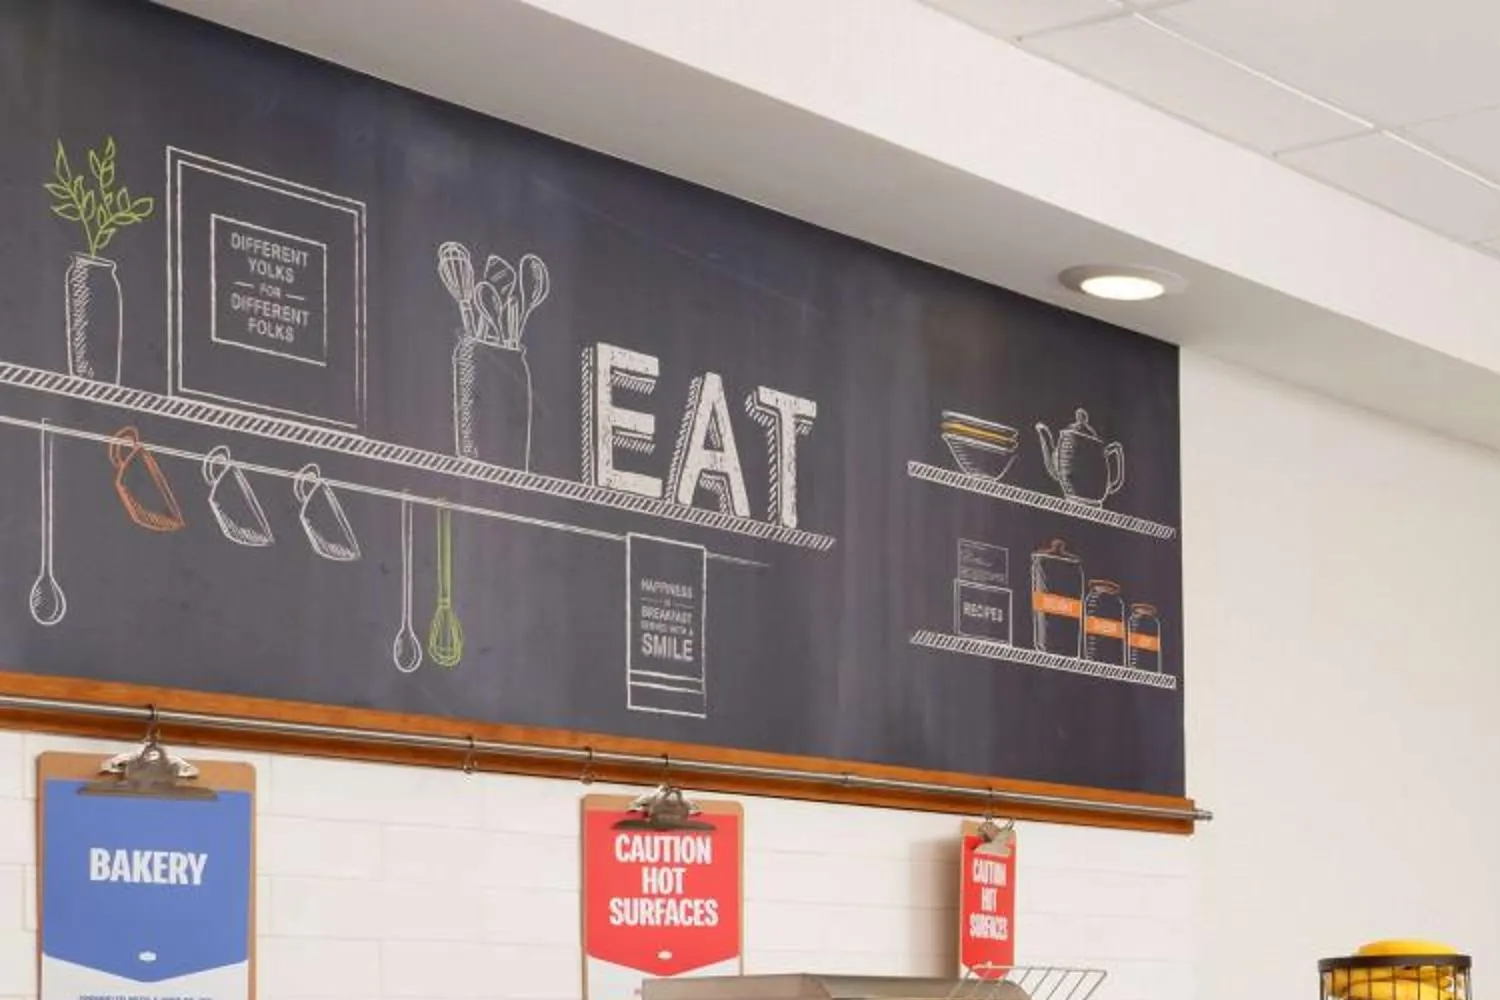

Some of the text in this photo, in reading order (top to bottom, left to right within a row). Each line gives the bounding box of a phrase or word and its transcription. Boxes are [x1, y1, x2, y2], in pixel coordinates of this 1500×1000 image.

[231, 232, 308, 268] DIFFERENT
[248, 257, 294, 284] YOLKS
[260, 283, 281, 298] FOR
[231, 292, 309, 327] DIFFERENT
[248, 317, 294, 342] FOLKS
[582, 342, 817, 528] EAT
[963, 601, 1003, 622] RECIPES
[641, 632, 693, 661] SMILE
[615, 833, 713, 865] CAUTION
[90, 847, 208, 886] BAKERY
[641, 867, 686, 895] HOT
[972, 858, 1006, 886] CAUTION
[609, 897, 719, 928] SURFACES
[969, 912, 1008, 941] SURFACES
